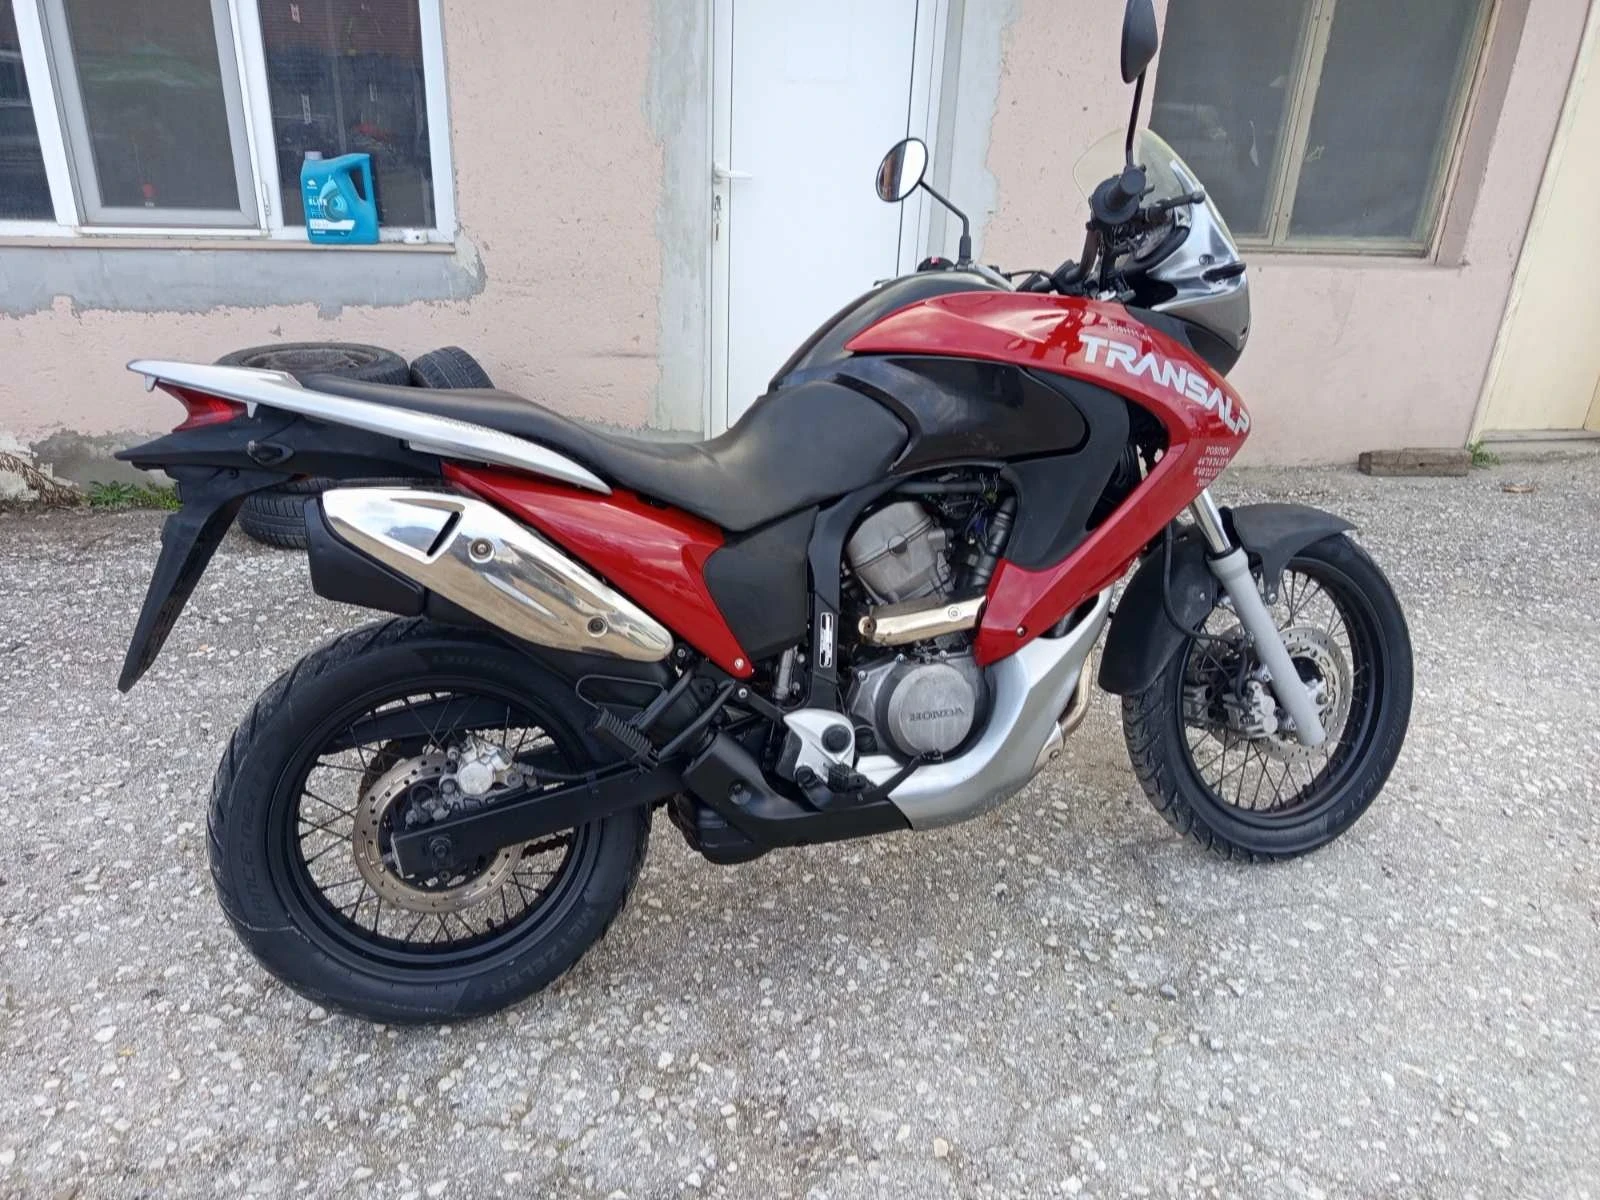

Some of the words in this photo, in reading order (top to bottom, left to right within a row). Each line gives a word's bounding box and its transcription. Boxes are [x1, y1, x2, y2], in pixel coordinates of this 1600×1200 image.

[1078, 333, 1250, 436] TRANSALP
[1205, 445, 1231, 456] POSITION
[909, 707, 964, 721] HONDA
